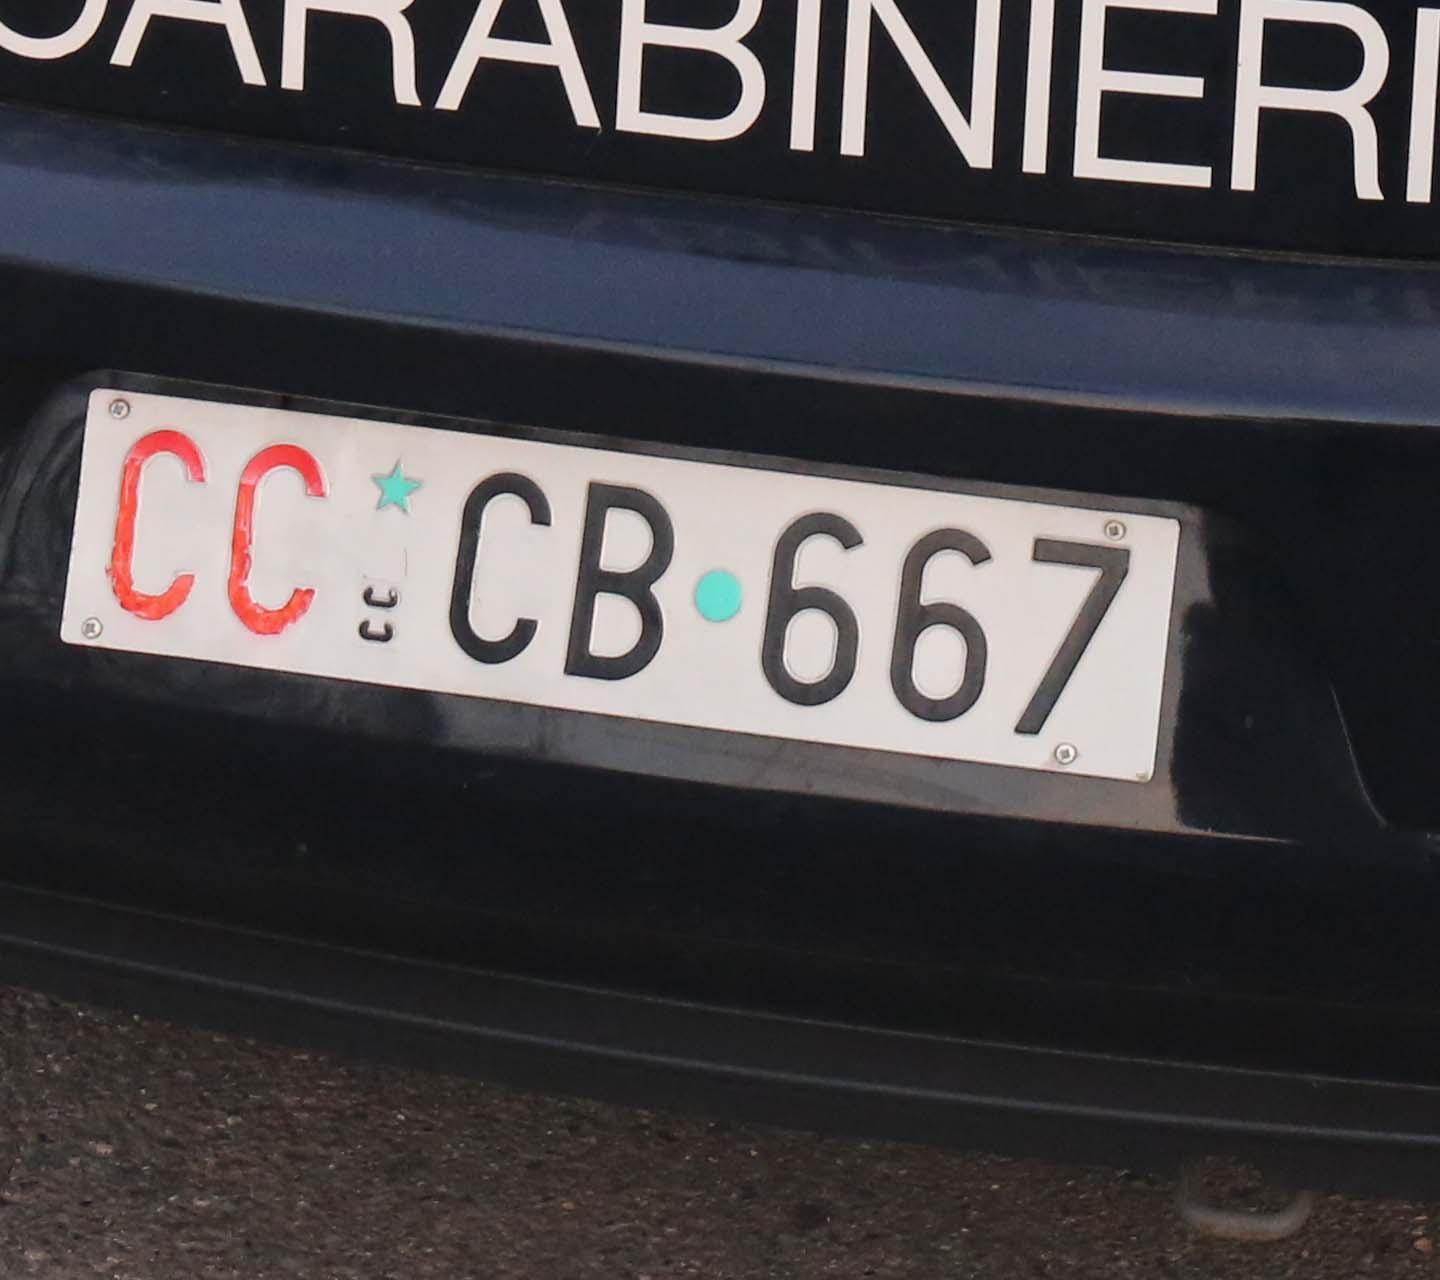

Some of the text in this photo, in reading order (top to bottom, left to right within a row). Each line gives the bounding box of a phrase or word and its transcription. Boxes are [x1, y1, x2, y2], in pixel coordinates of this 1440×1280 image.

[105, 428, 1133, 737] CC CB 667
